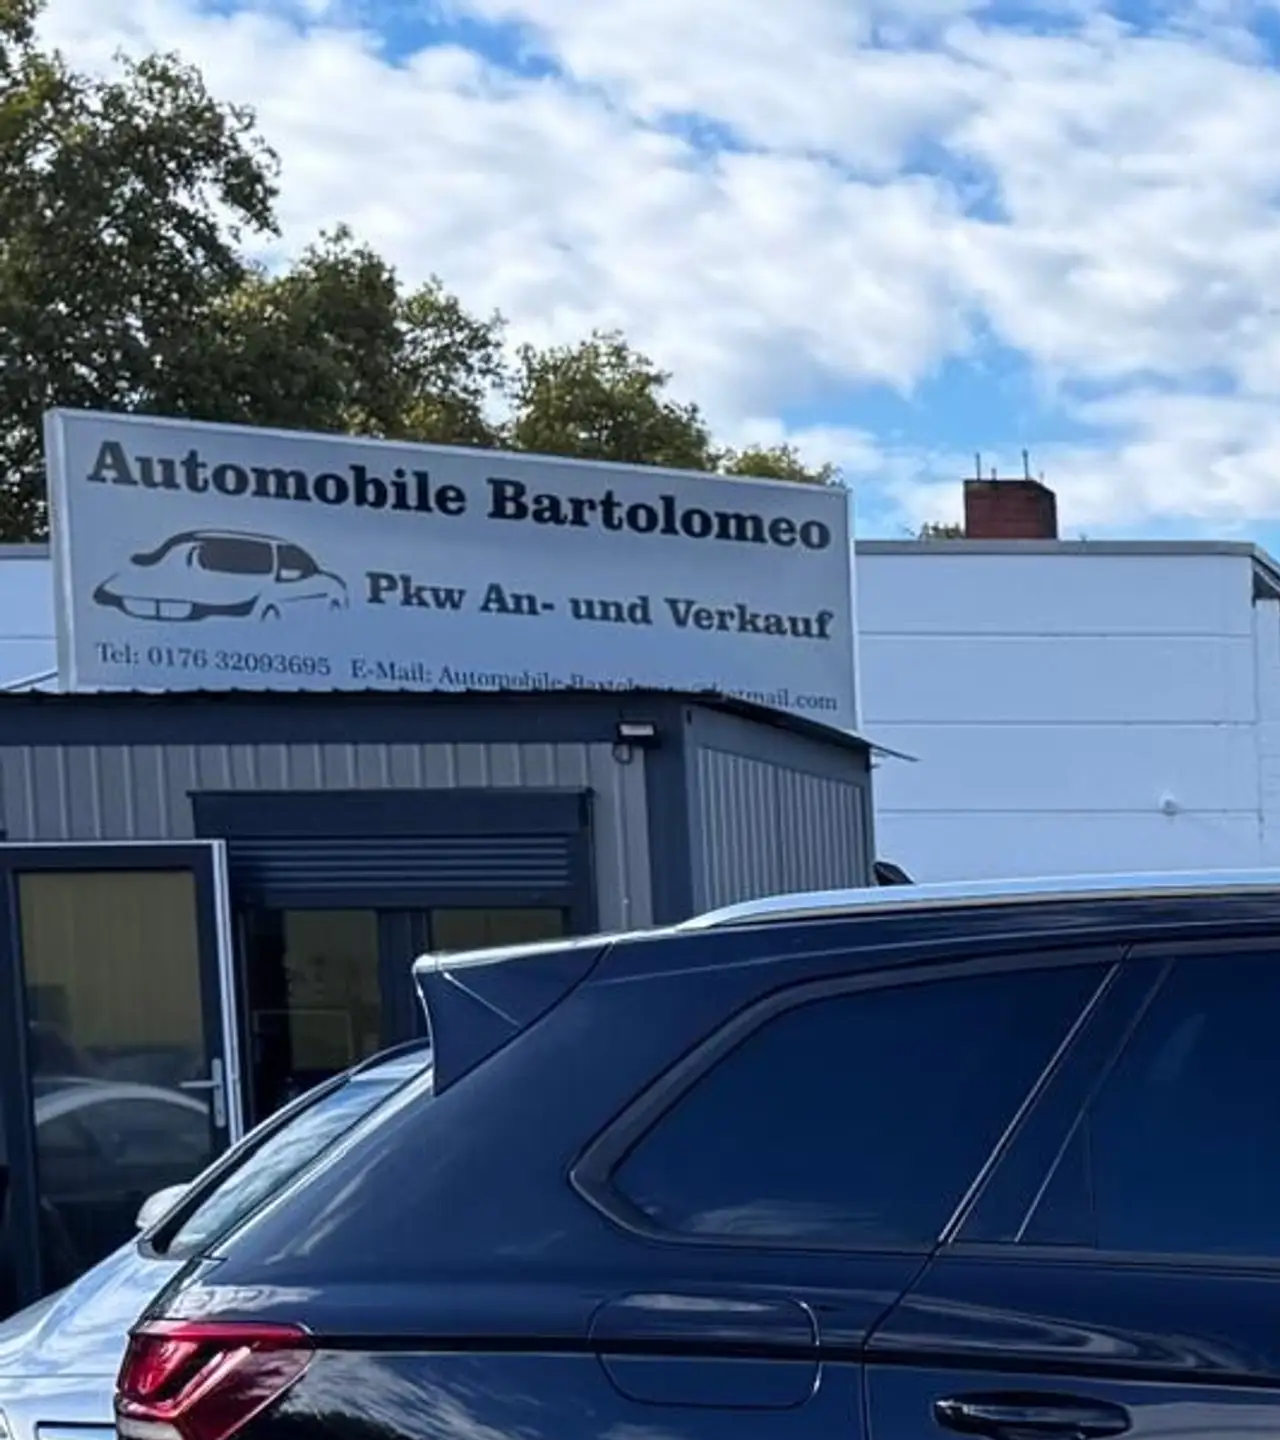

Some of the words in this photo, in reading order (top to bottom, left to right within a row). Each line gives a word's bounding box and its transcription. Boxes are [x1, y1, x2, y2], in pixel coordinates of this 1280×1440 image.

[87, 440, 467, 516] Automobile
[486, 477, 832, 550] Bartolomeo
[365, 571, 467, 611] Pkw
[480, 582, 555, 616] An-
[571, 596, 652, 626] und
[664, 597, 834, 640] Verkauf
[97, 642, 140, 665] Tel:
[147, 646, 208, 669] 0176
[215, 651, 331, 676] 32093695
[351, 658, 432, 683] E-Mail:
